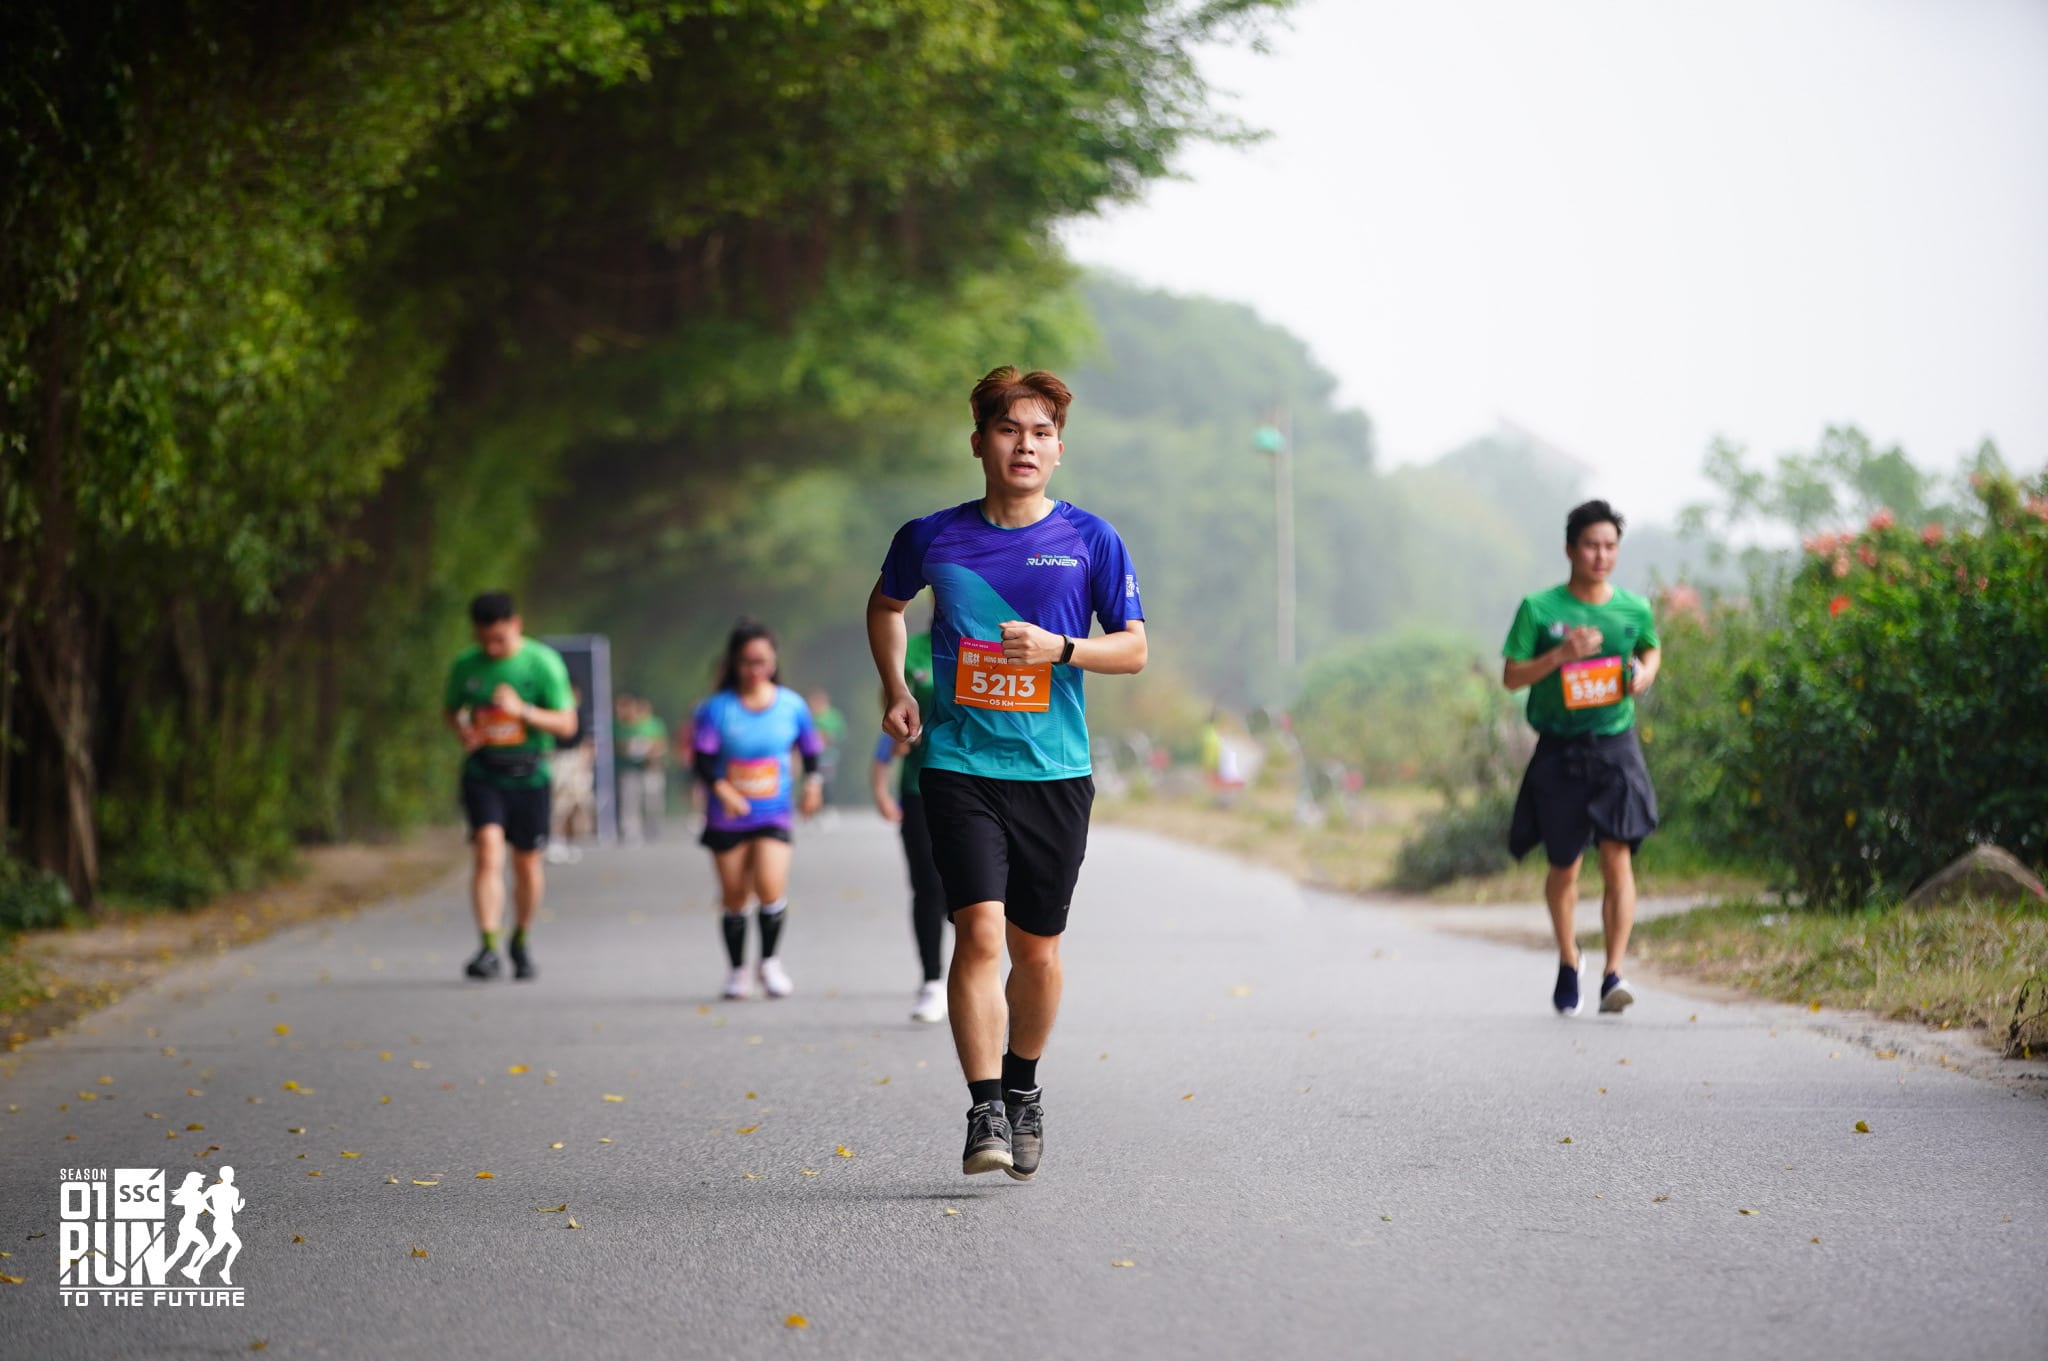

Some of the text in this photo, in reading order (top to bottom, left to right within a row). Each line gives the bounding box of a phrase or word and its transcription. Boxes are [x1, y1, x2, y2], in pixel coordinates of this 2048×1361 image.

[1026, 558, 1078, 567] RUNNER
[971, 671, 1036, 697] 5213
[989, 698, 1015, 707] 05 KM
